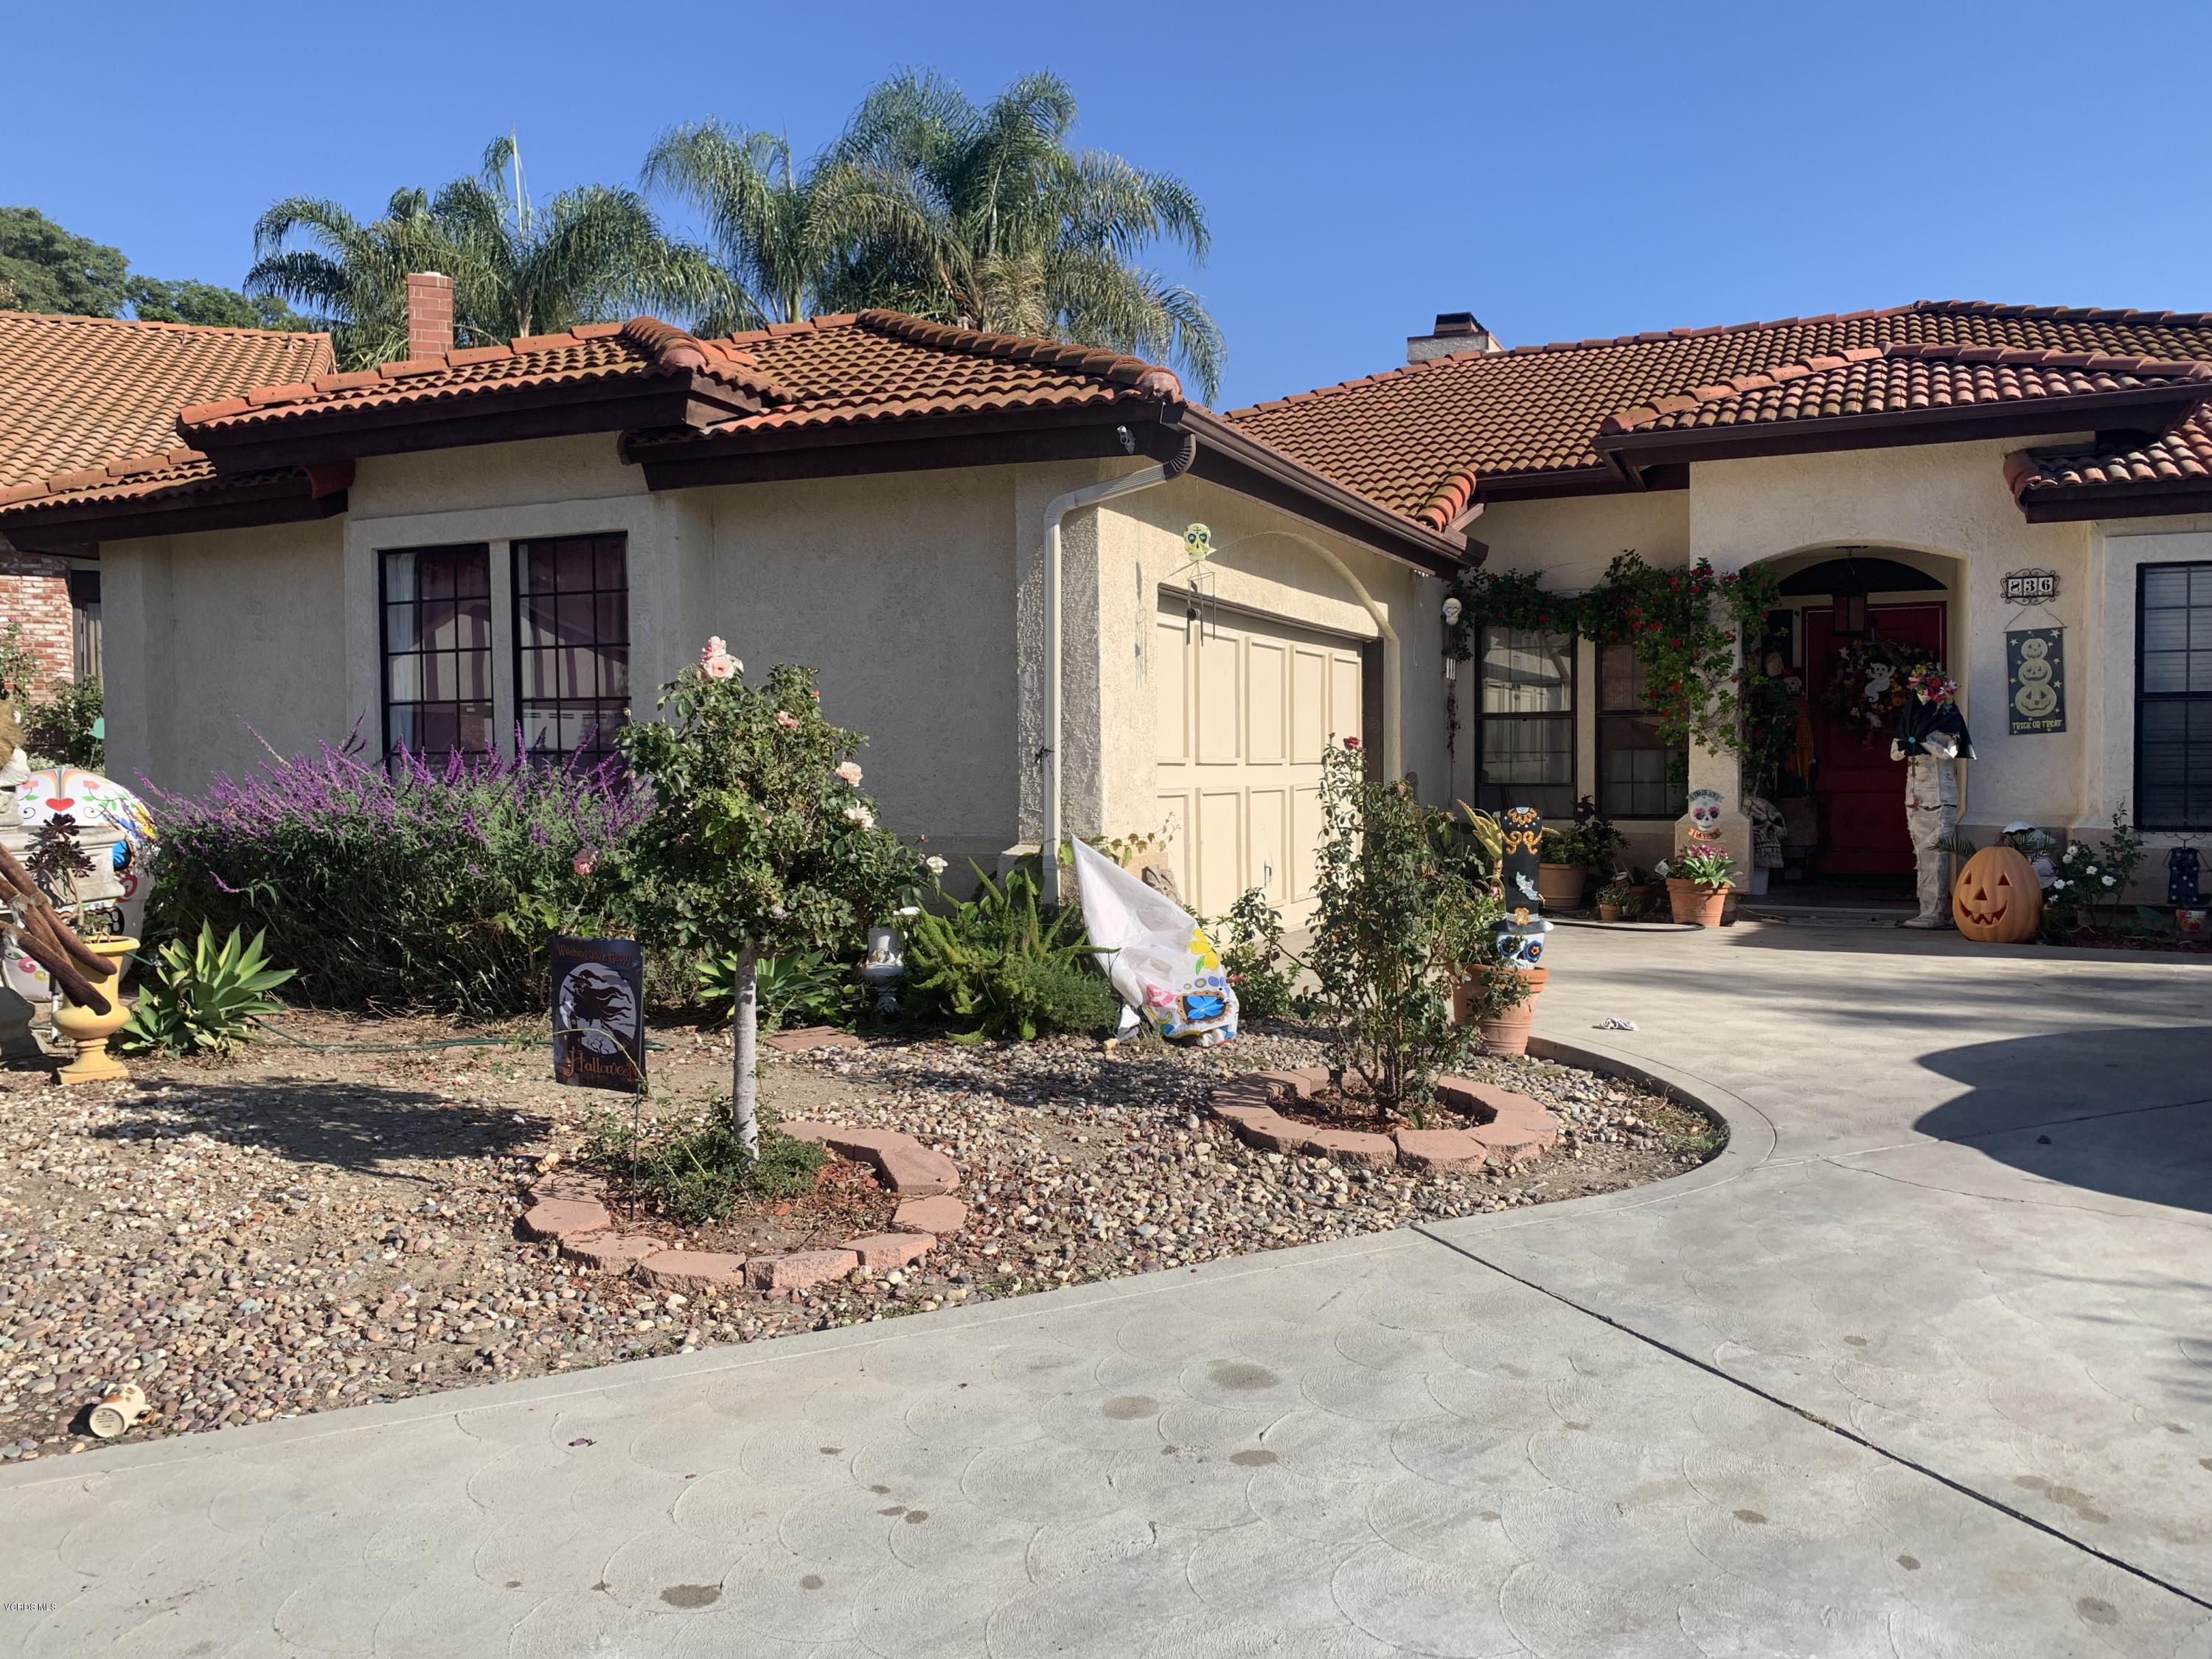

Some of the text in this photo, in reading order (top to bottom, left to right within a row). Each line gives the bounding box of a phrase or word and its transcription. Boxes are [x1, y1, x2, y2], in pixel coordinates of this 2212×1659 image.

[2011, 579, 2050, 592] 836
[2012, 720, 2062, 730] TRICK OR TREAT
[557, 943, 588, 960] Witching
